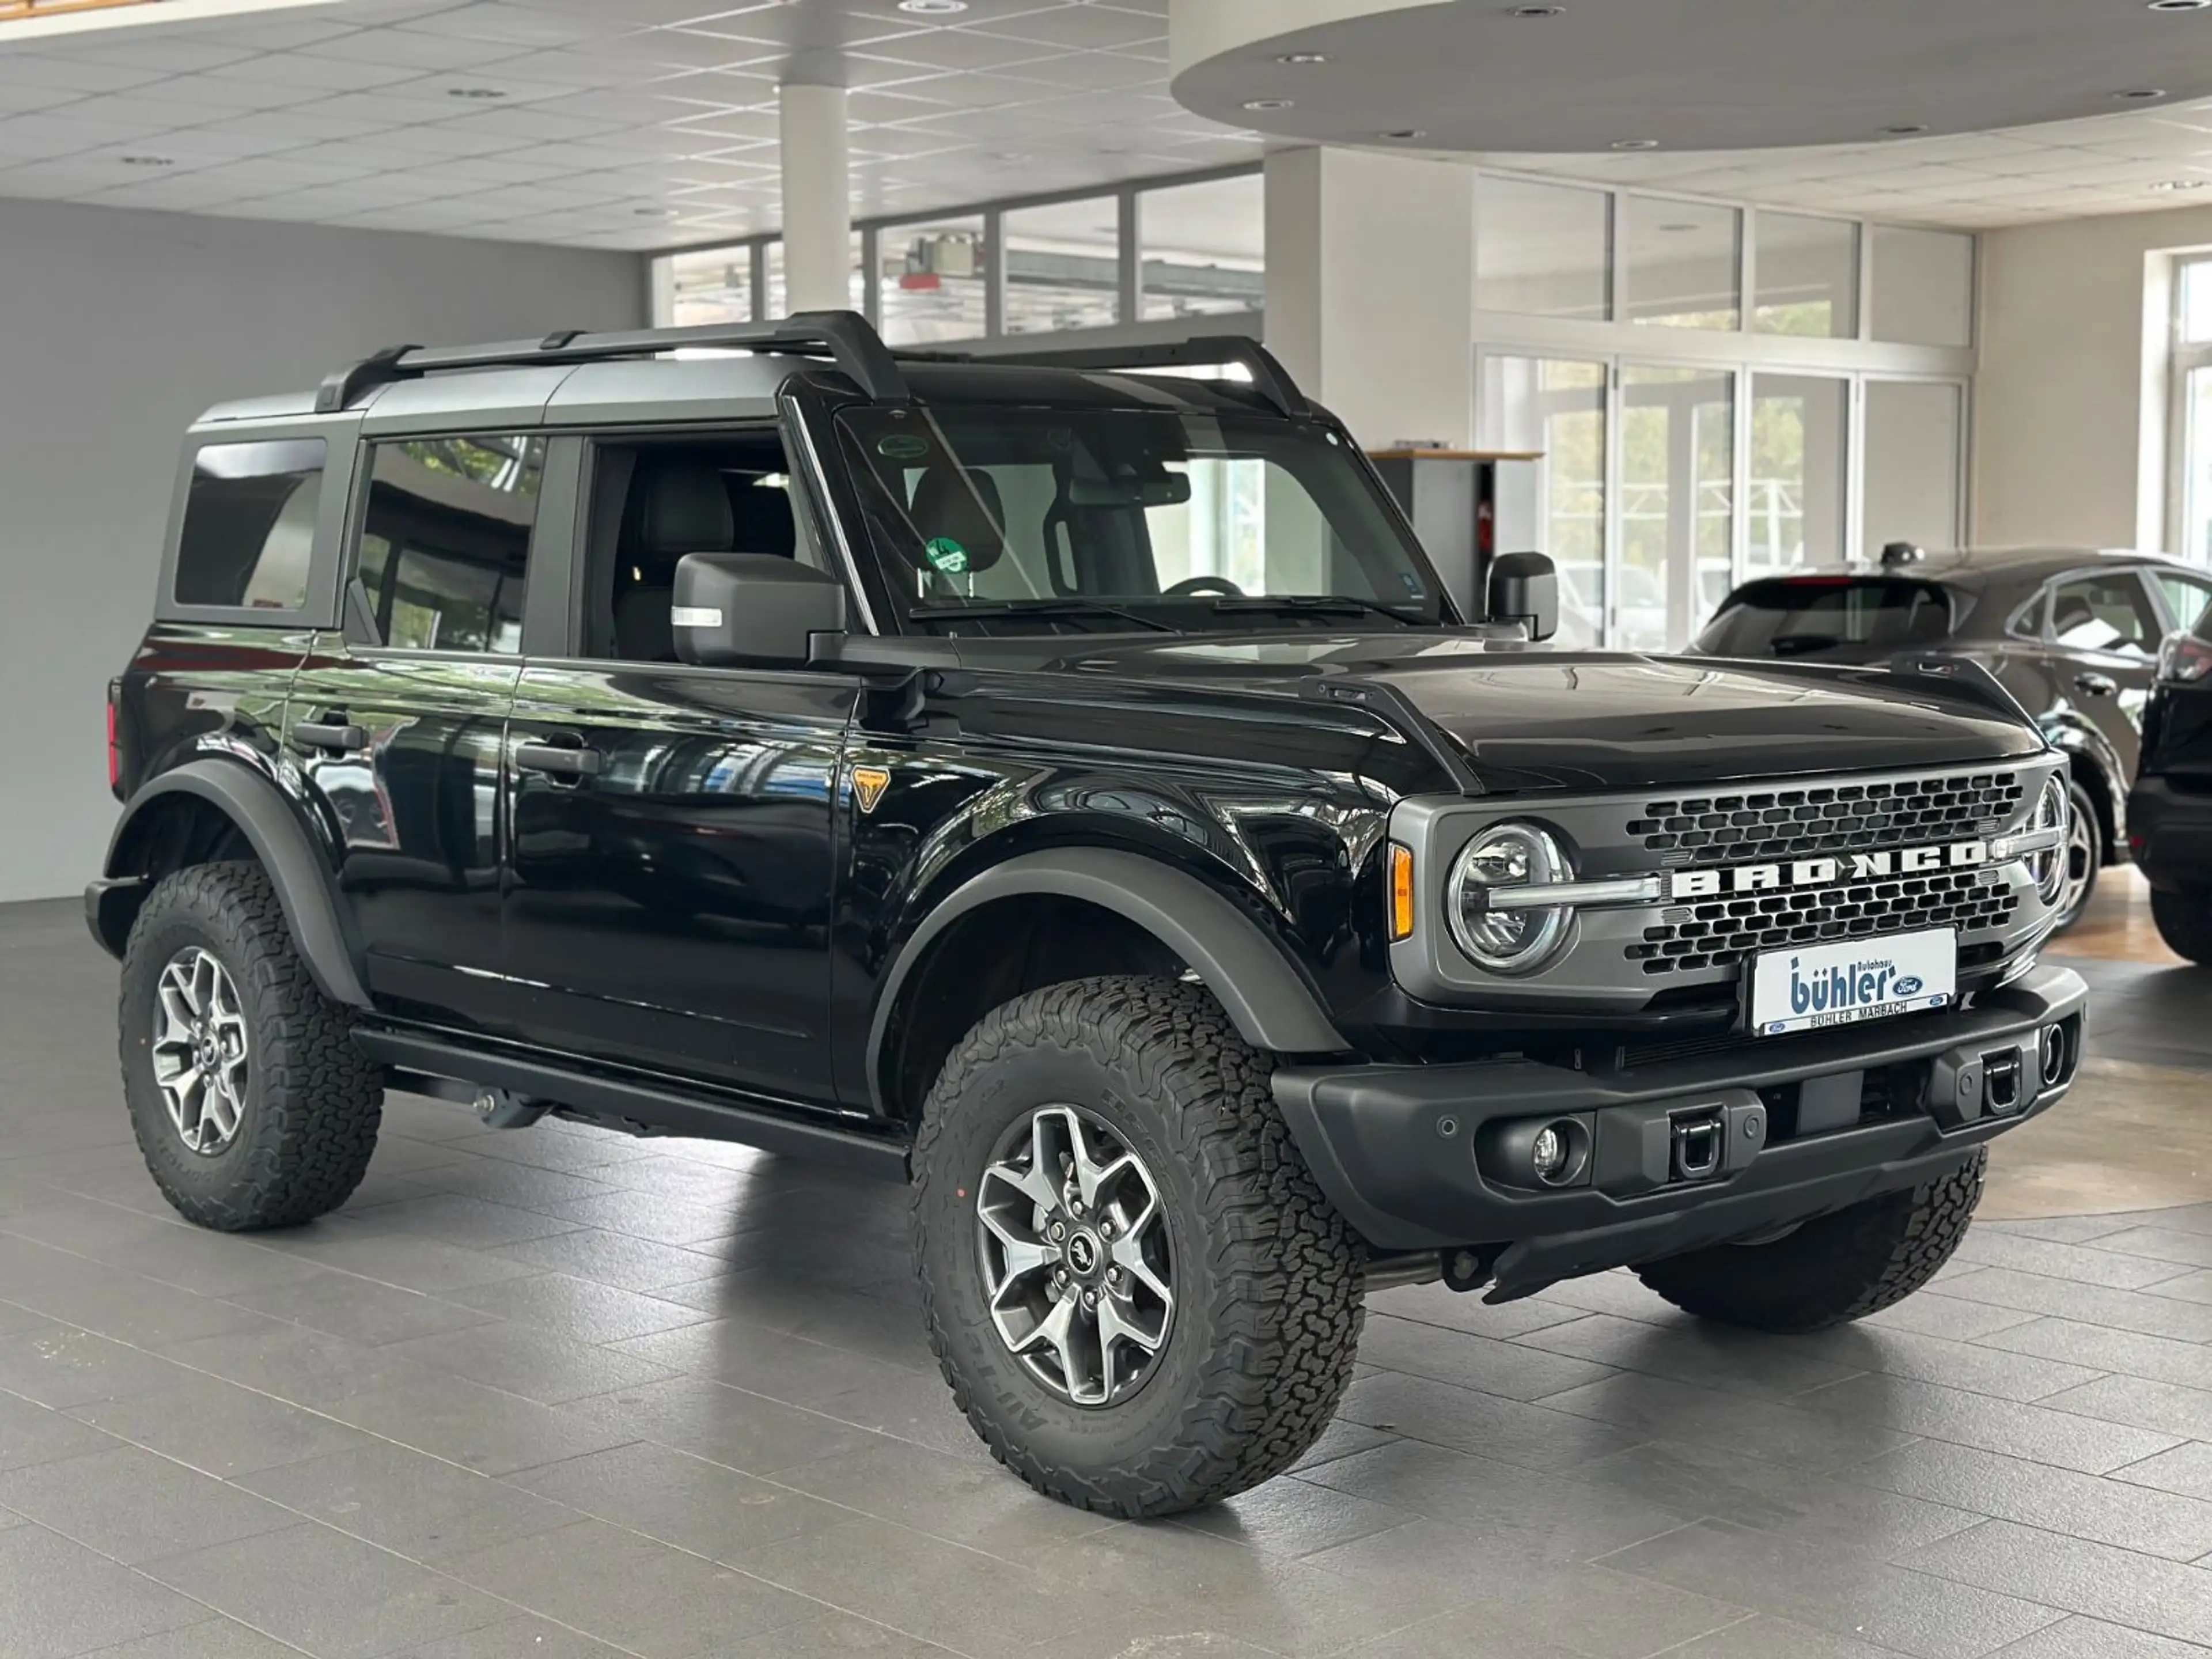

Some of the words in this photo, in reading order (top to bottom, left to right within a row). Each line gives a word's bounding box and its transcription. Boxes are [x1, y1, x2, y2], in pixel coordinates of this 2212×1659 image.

[1672, 841, 1987, 898] BRONCO
[1791, 957, 1896, 1014] bühler
[1858, 1002, 1907, 1018] MARBACH
